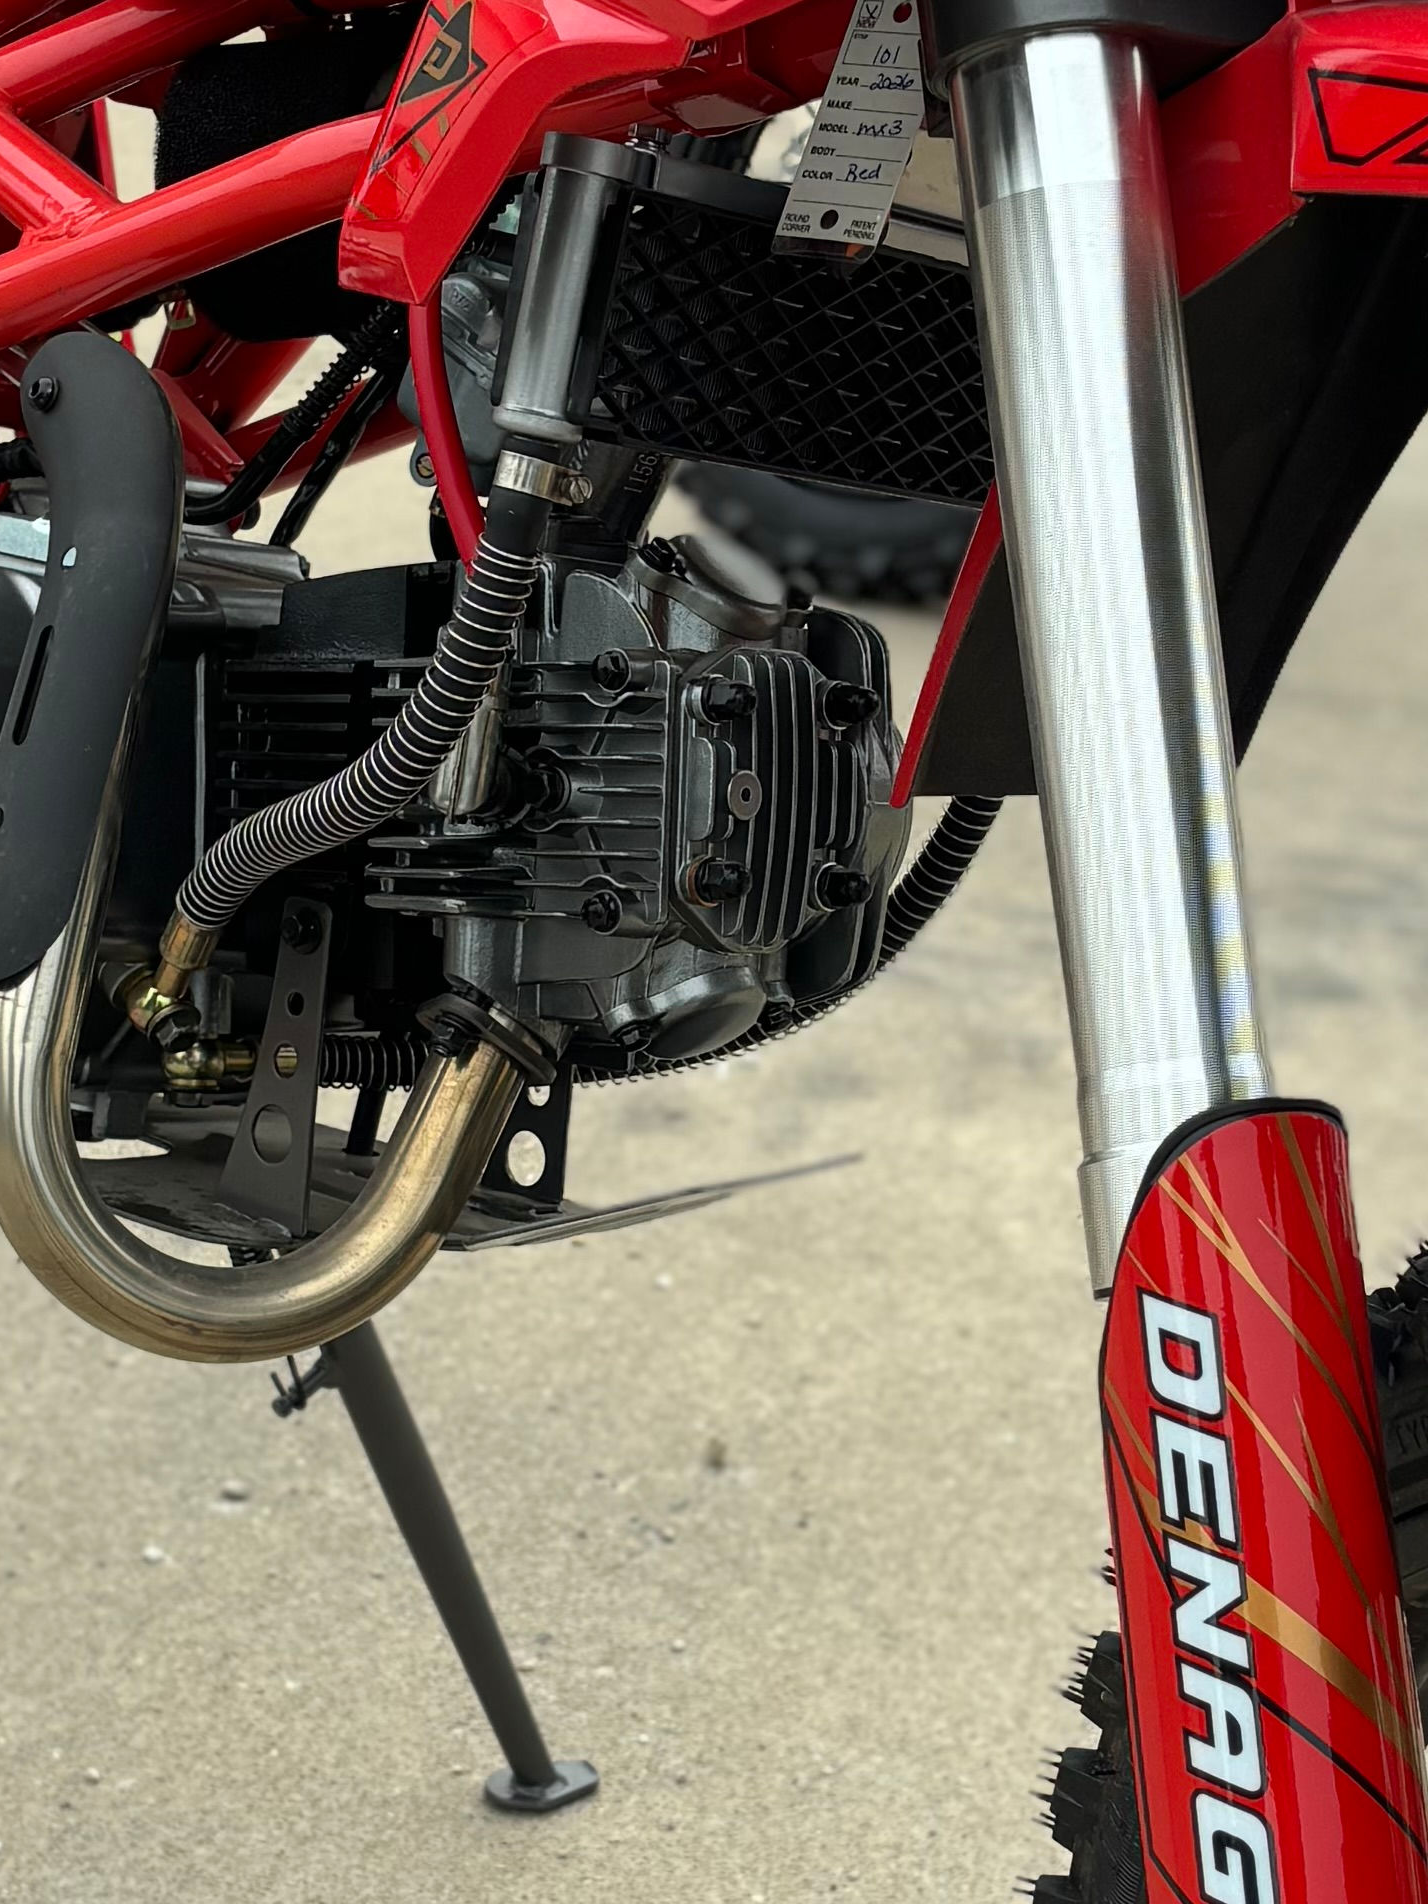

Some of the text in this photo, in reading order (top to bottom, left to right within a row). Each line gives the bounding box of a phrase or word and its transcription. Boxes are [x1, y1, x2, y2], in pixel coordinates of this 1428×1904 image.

[873, 45, 900, 64] 101
[836, 73, 914, 90] YEAR 2026
[827, 100, 852, 110] MAKE
[819, 124, 848, 134] MODEL
[811, 146, 836, 156] BODY
[802, 164, 882, 181] COLOR Red
